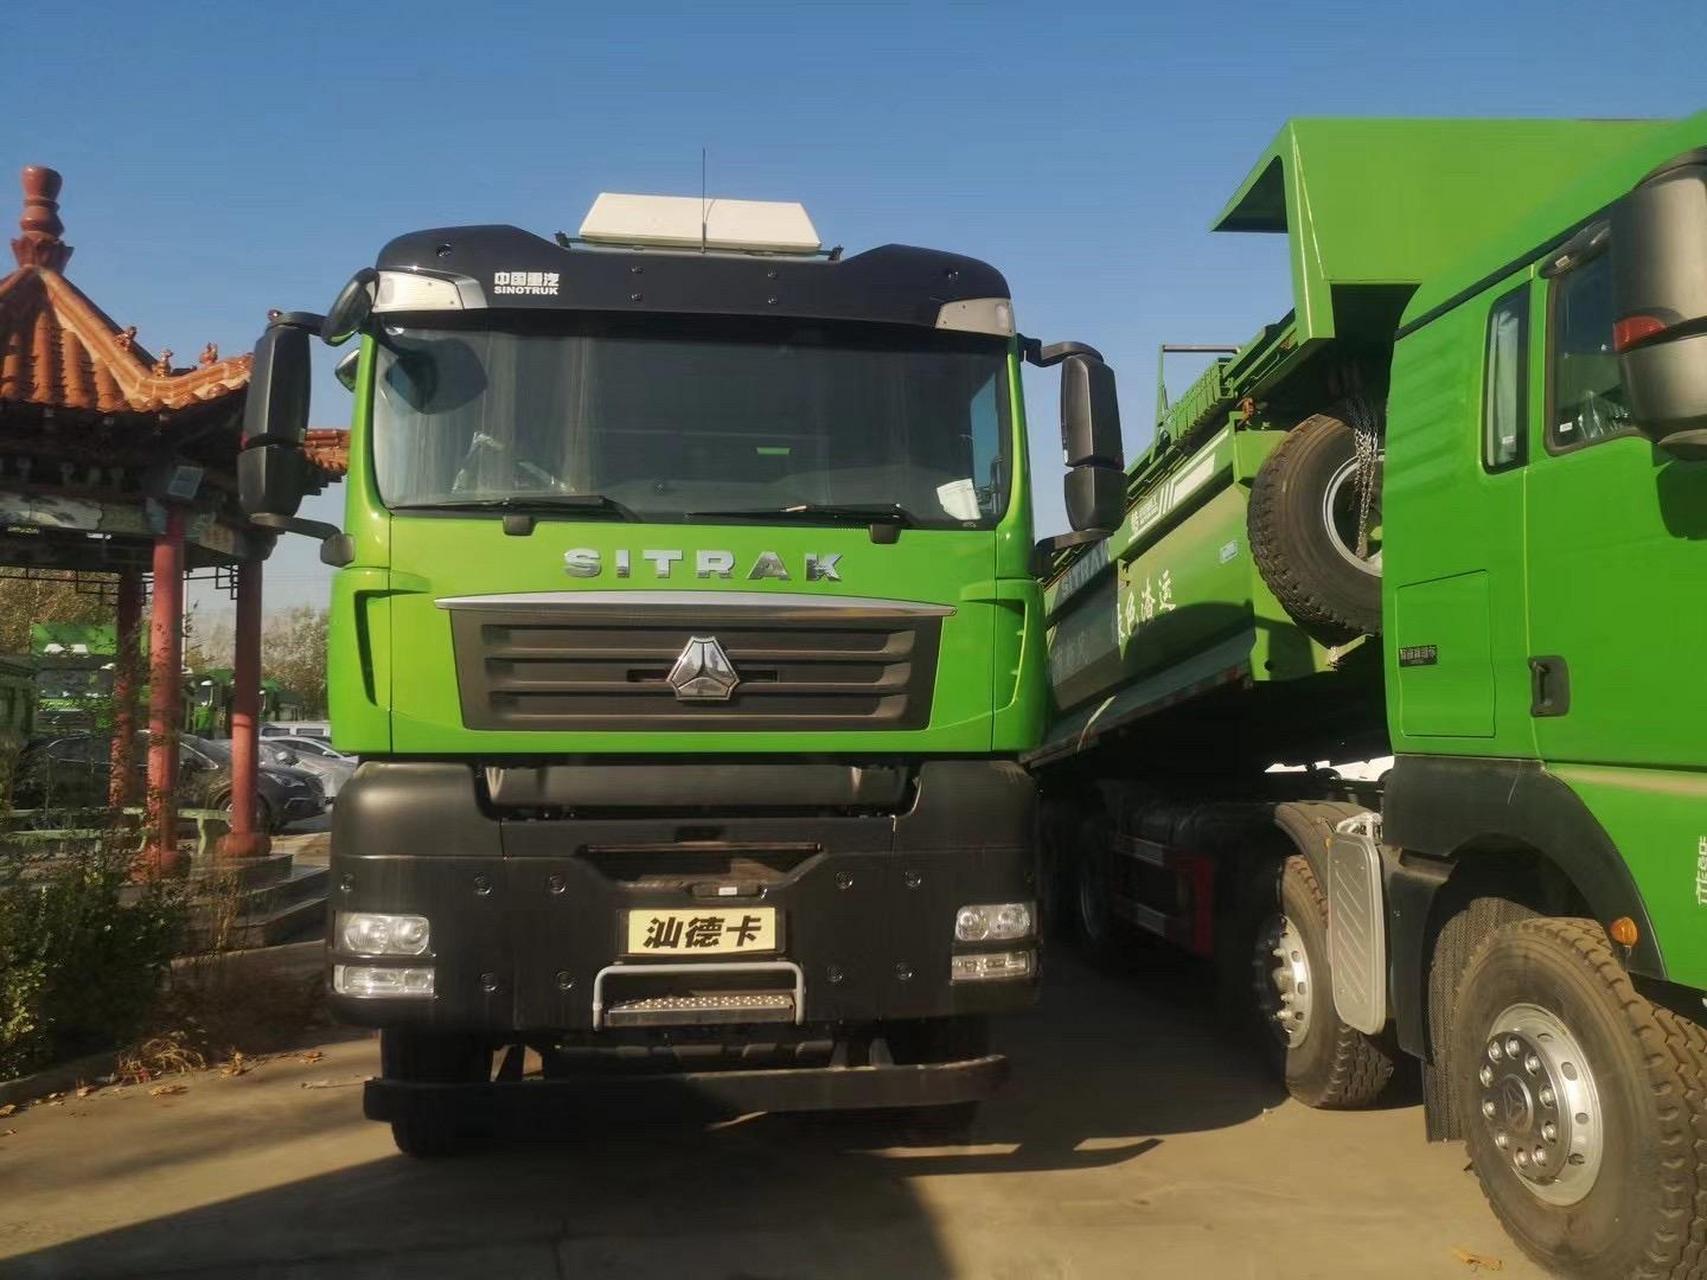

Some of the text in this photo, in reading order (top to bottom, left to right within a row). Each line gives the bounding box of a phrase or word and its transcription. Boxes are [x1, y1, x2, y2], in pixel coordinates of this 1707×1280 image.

[494, 286, 559, 295] SINOTRUK
[563, 547, 844, 582] SITRAK
[643, 915, 762, 949] 汕德卡
